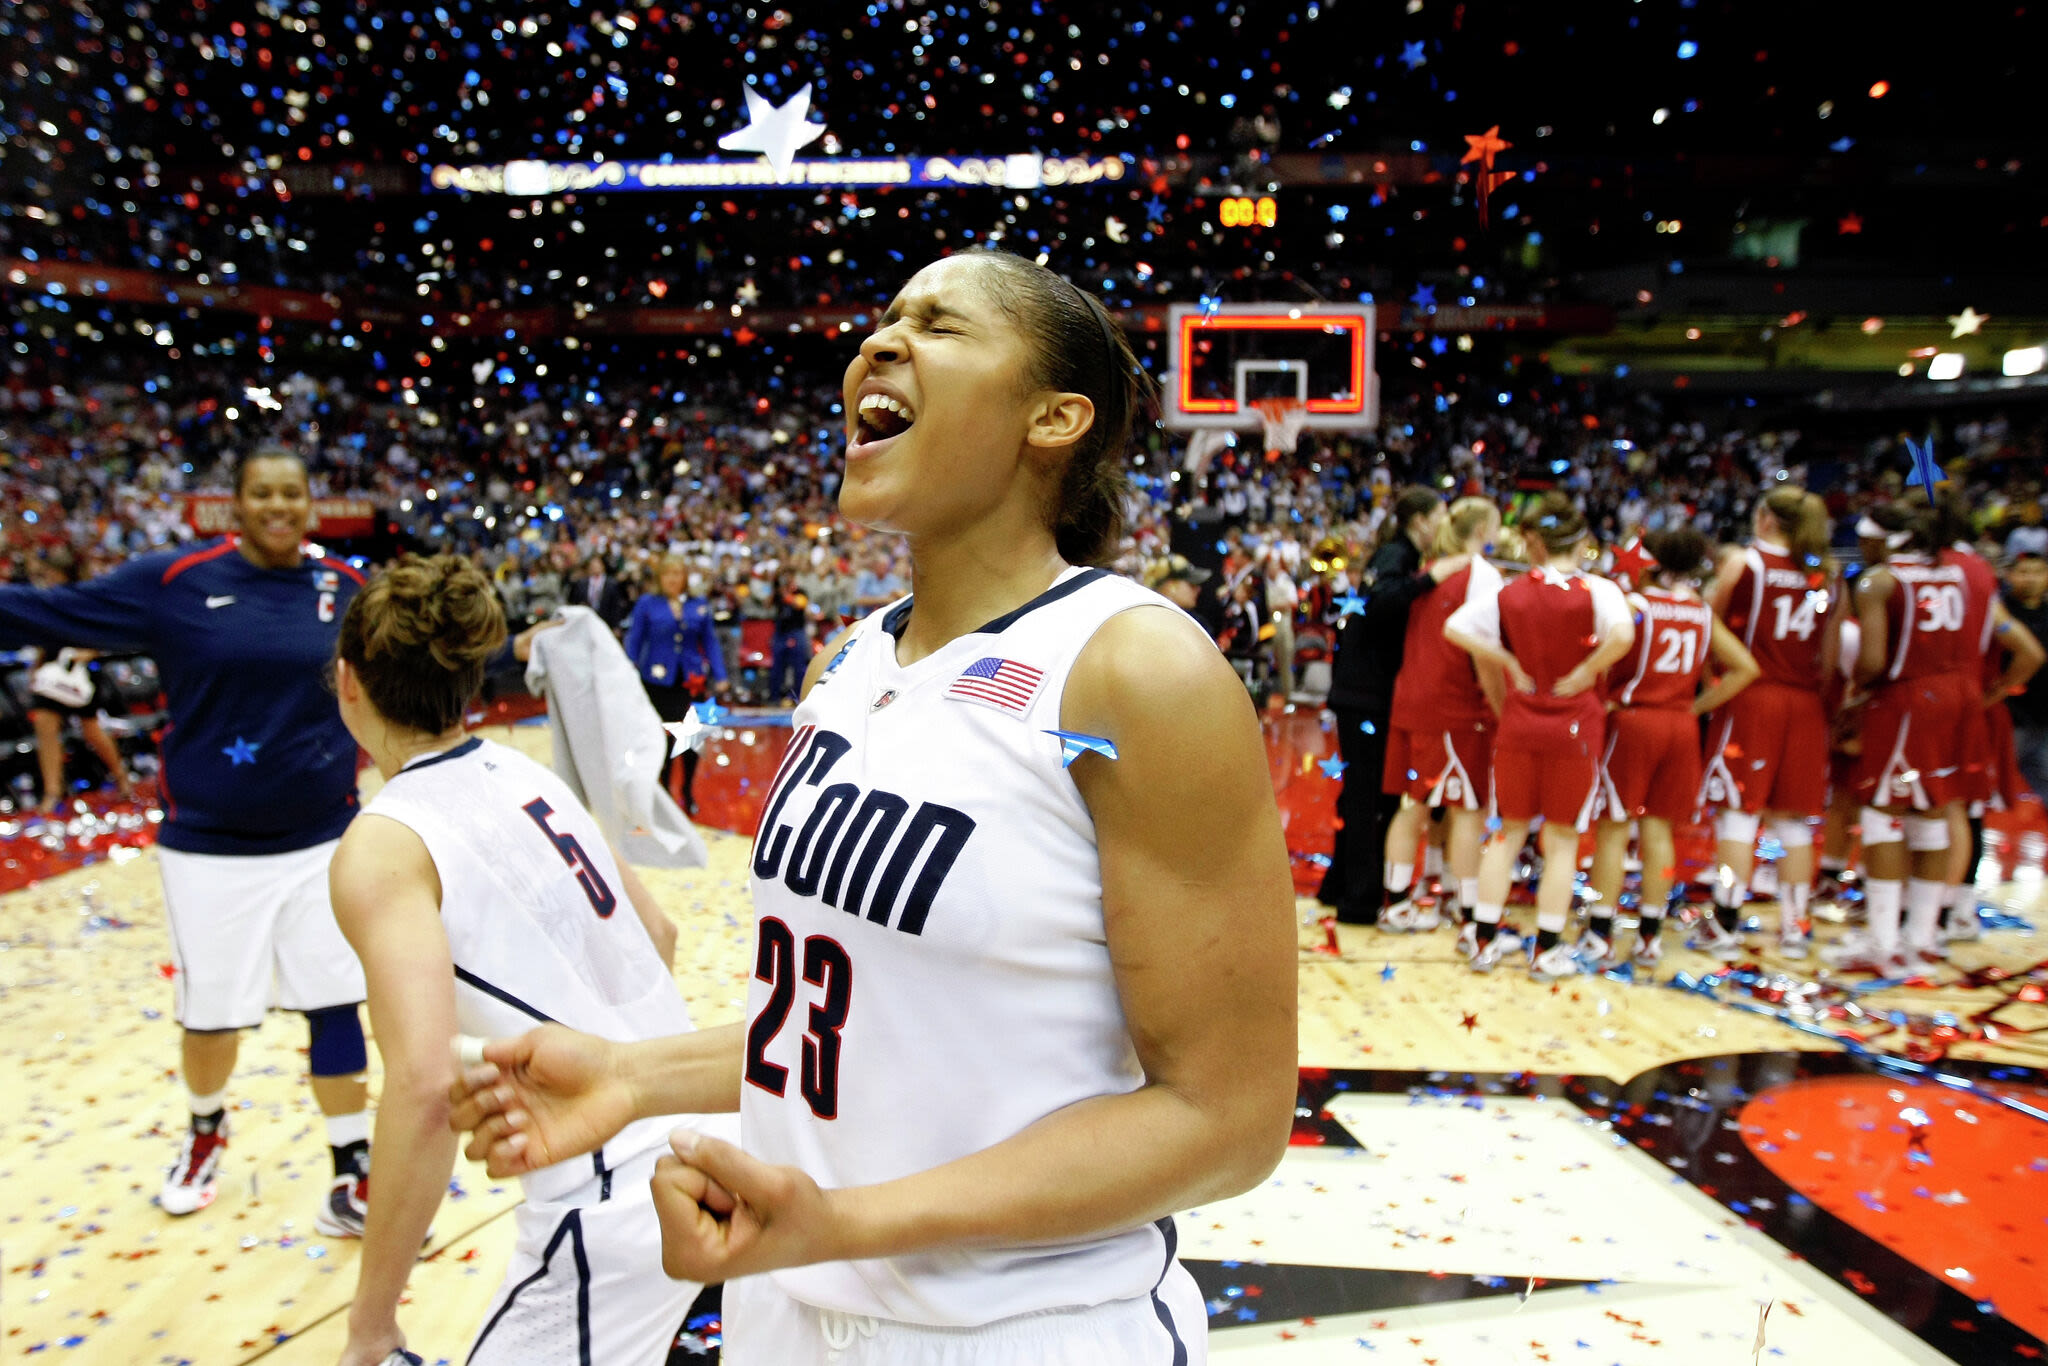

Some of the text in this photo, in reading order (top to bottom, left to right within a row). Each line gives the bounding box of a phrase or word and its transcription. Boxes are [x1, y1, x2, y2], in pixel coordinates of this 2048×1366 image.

[1773, 595, 1816, 641] 14
[1917, 585, 1965, 632] 30
[1654, 627, 1697, 675] 21
[521, 796, 617, 920] 5
[745, 915, 852, 1121] 23
